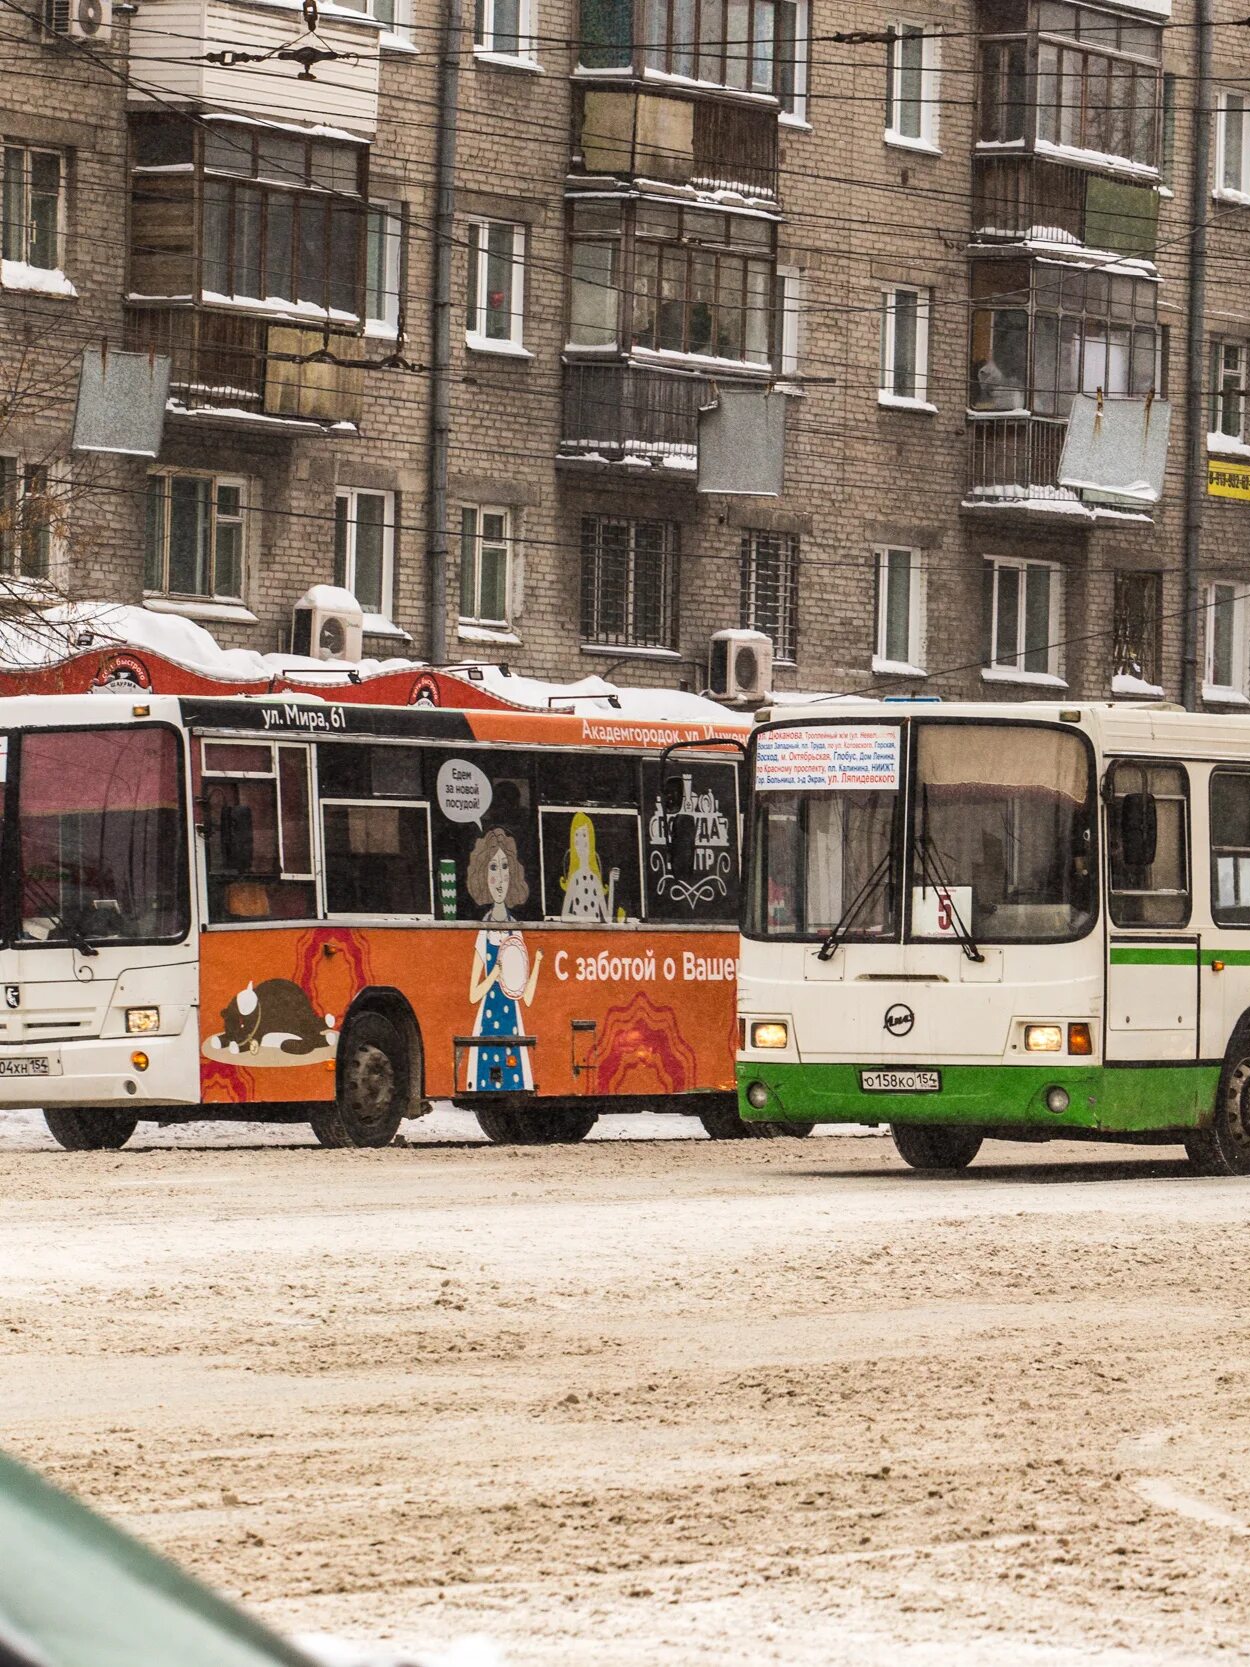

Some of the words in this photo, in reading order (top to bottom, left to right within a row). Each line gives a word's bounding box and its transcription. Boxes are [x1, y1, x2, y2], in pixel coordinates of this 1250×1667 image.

[110, 681, 137, 689] ШАУРМА
[262, 709, 284, 729] ул.
[284, 704, 330, 732] Мира,
[331, 706, 346, 728] 61
[452, 768, 472, 780] Едем
[828, 775, 839, 785] ул.
[841, 773, 895, 784] Ляпидевского
[446, 784, 454, 793] за
[456, 784, 480, 795] новой
[446, 798, 480, 810] посудой!
[938, 895, 952, 930] 5
[555, 950, 569, 981] С
[576, 949, 656, 981] заботой
[663, 957, 676, 981] о
[917, 1073, 938, 1084] 154
